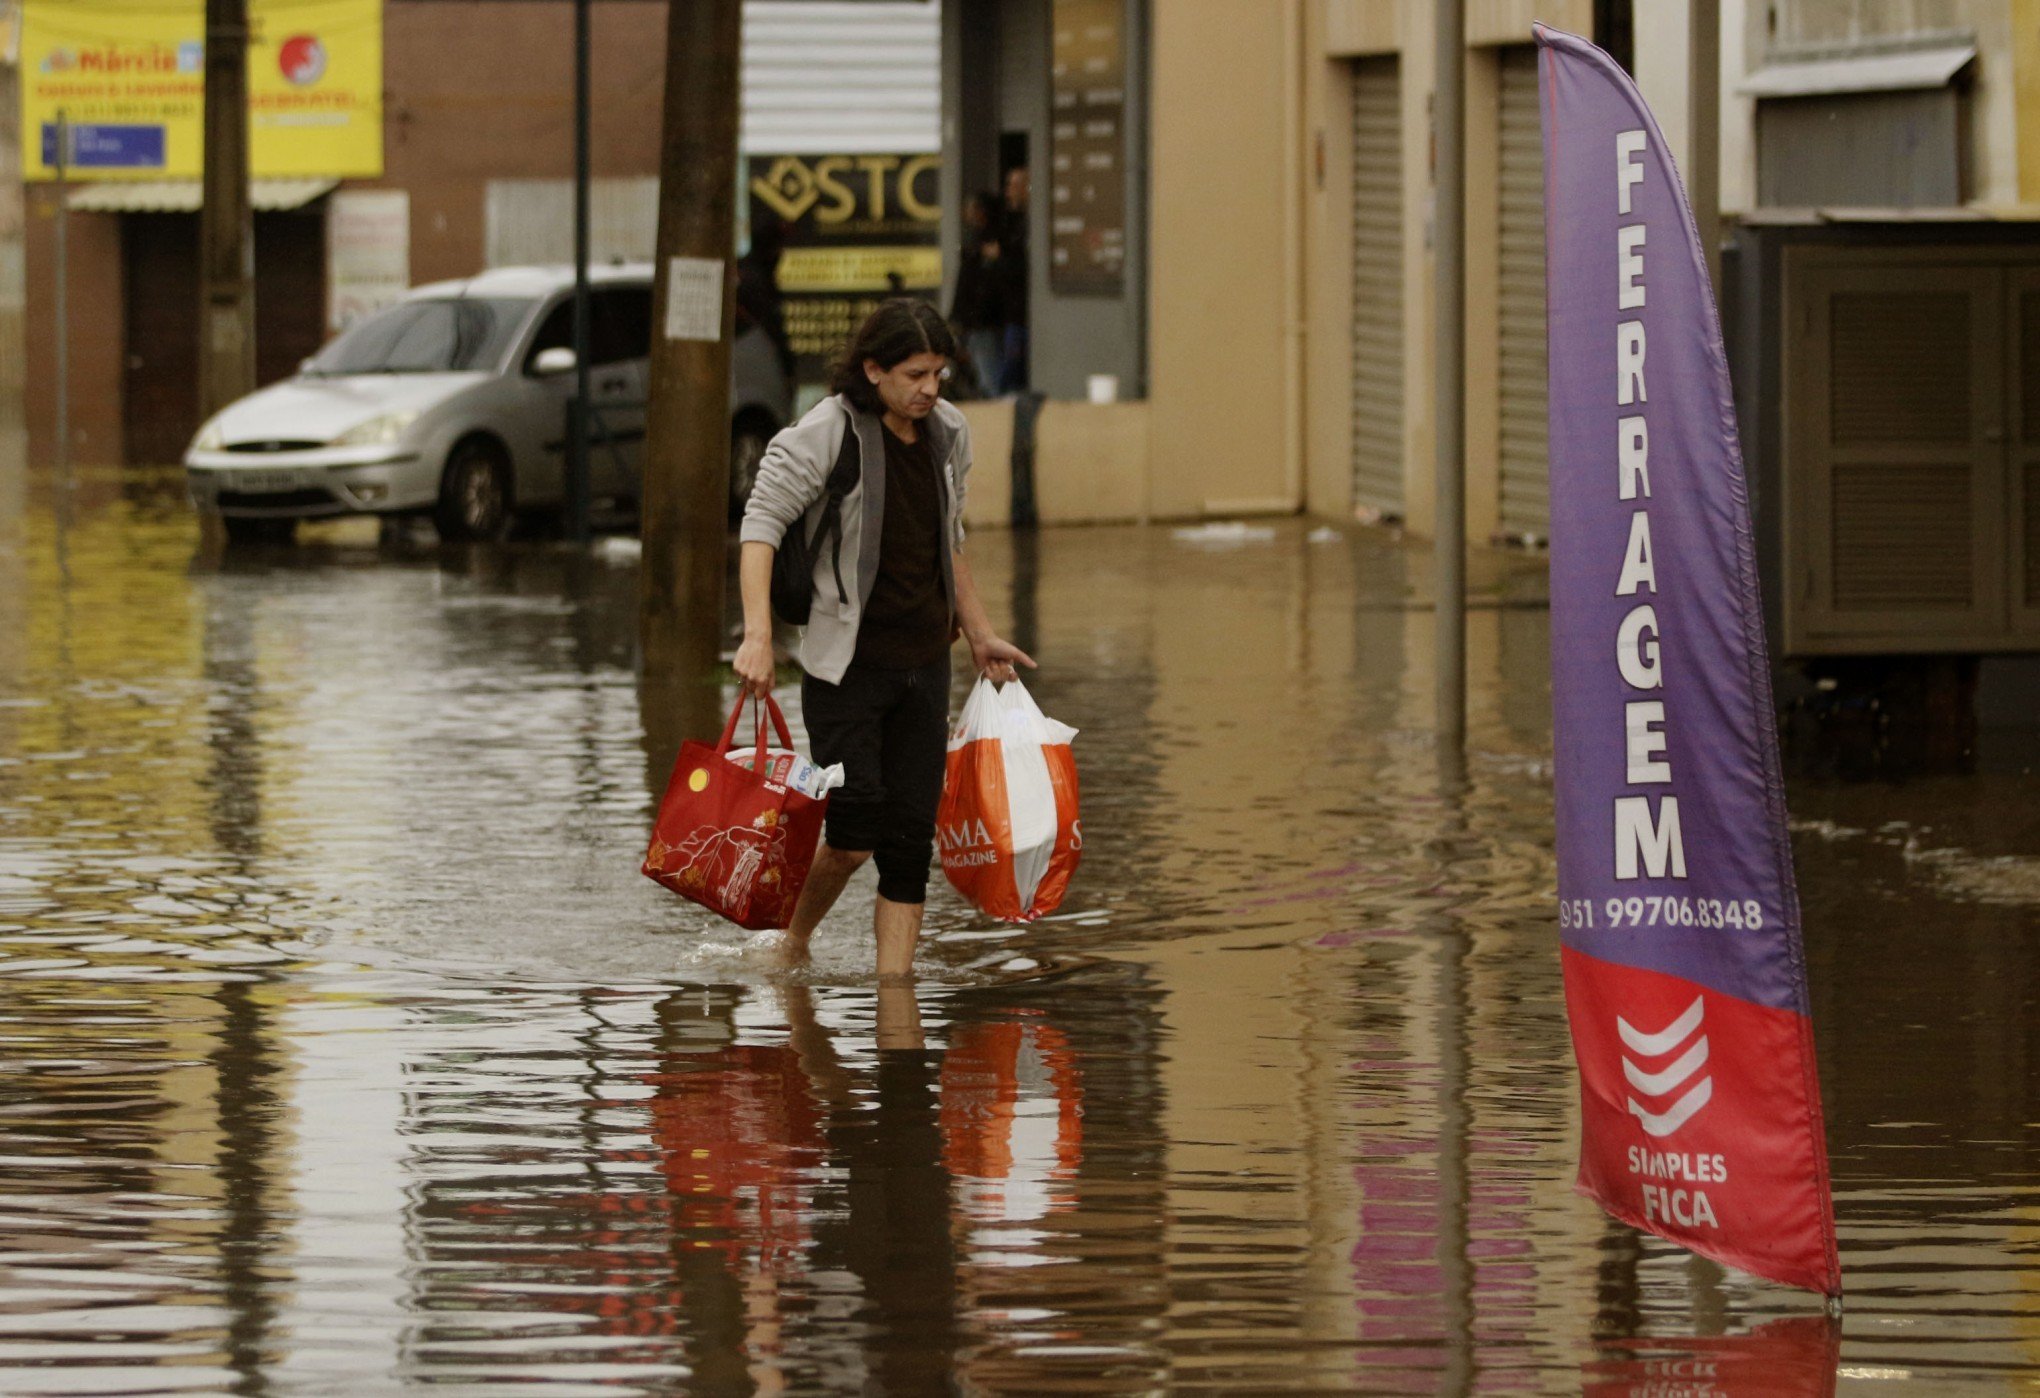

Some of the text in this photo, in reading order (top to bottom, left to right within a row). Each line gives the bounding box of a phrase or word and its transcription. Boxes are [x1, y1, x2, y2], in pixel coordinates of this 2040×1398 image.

[1614, 129, 1688, 880] FERRAGEM
[1573, 896, 1764, 930] 51 99706.8348
[1628, 1144, 1728, 1183] SIMPLES
[1641, 1183, 1719, 1229] FICA
